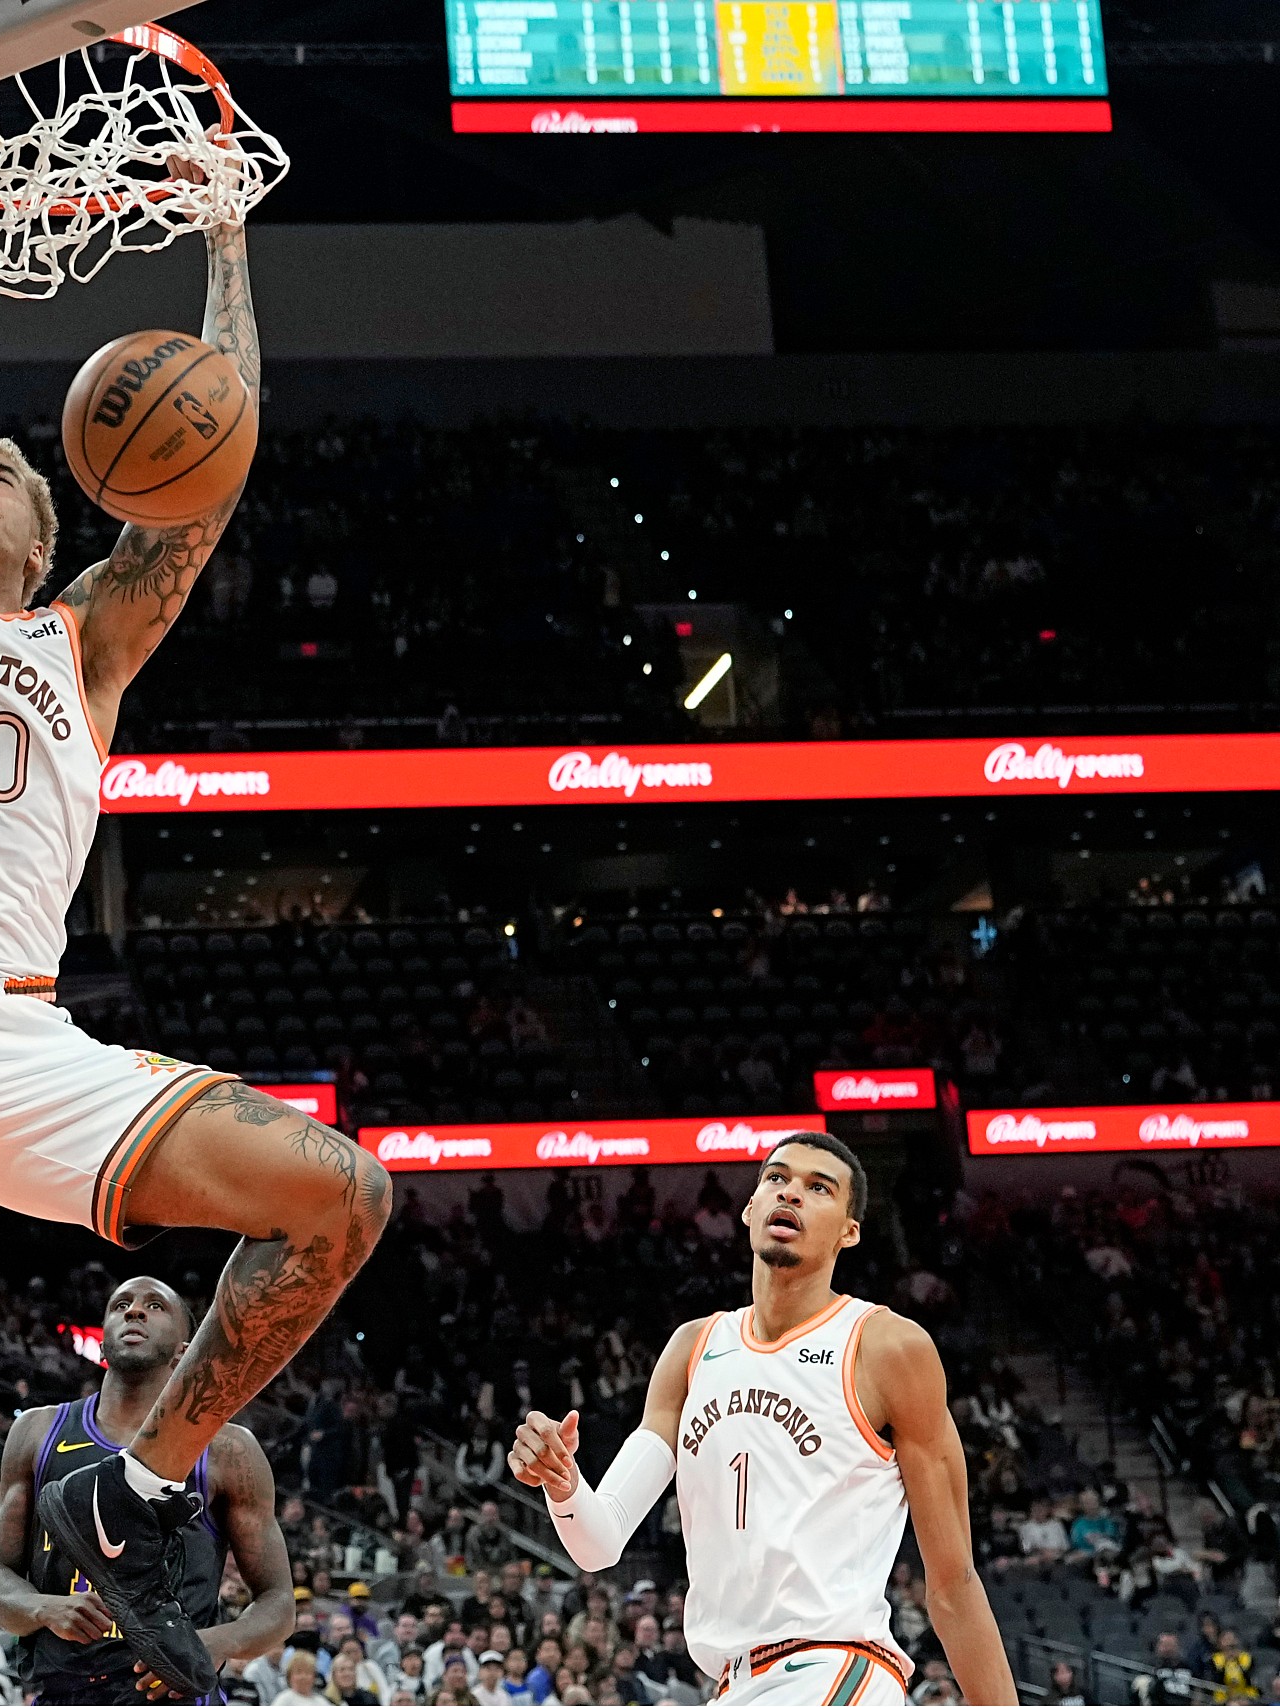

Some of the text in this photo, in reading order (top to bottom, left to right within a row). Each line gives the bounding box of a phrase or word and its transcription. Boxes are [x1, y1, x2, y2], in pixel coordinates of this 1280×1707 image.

[93, 338, 195, 429] Wilson
[102, 760, 270, 807] Bally SPORTS
[548, 751, 713, 797] Bally SPORTS
[984, 742, 1144, 789] Bally SPORTS
[377, 1131, 442, 1165] Bally
[985, 1114, 1049, 1147] Bally
[798, 1348, 835, 1365] Self.
[683, 1388, 822, 1457] SAN ANTONIO
[729, 1452, 749, 1530] 1
